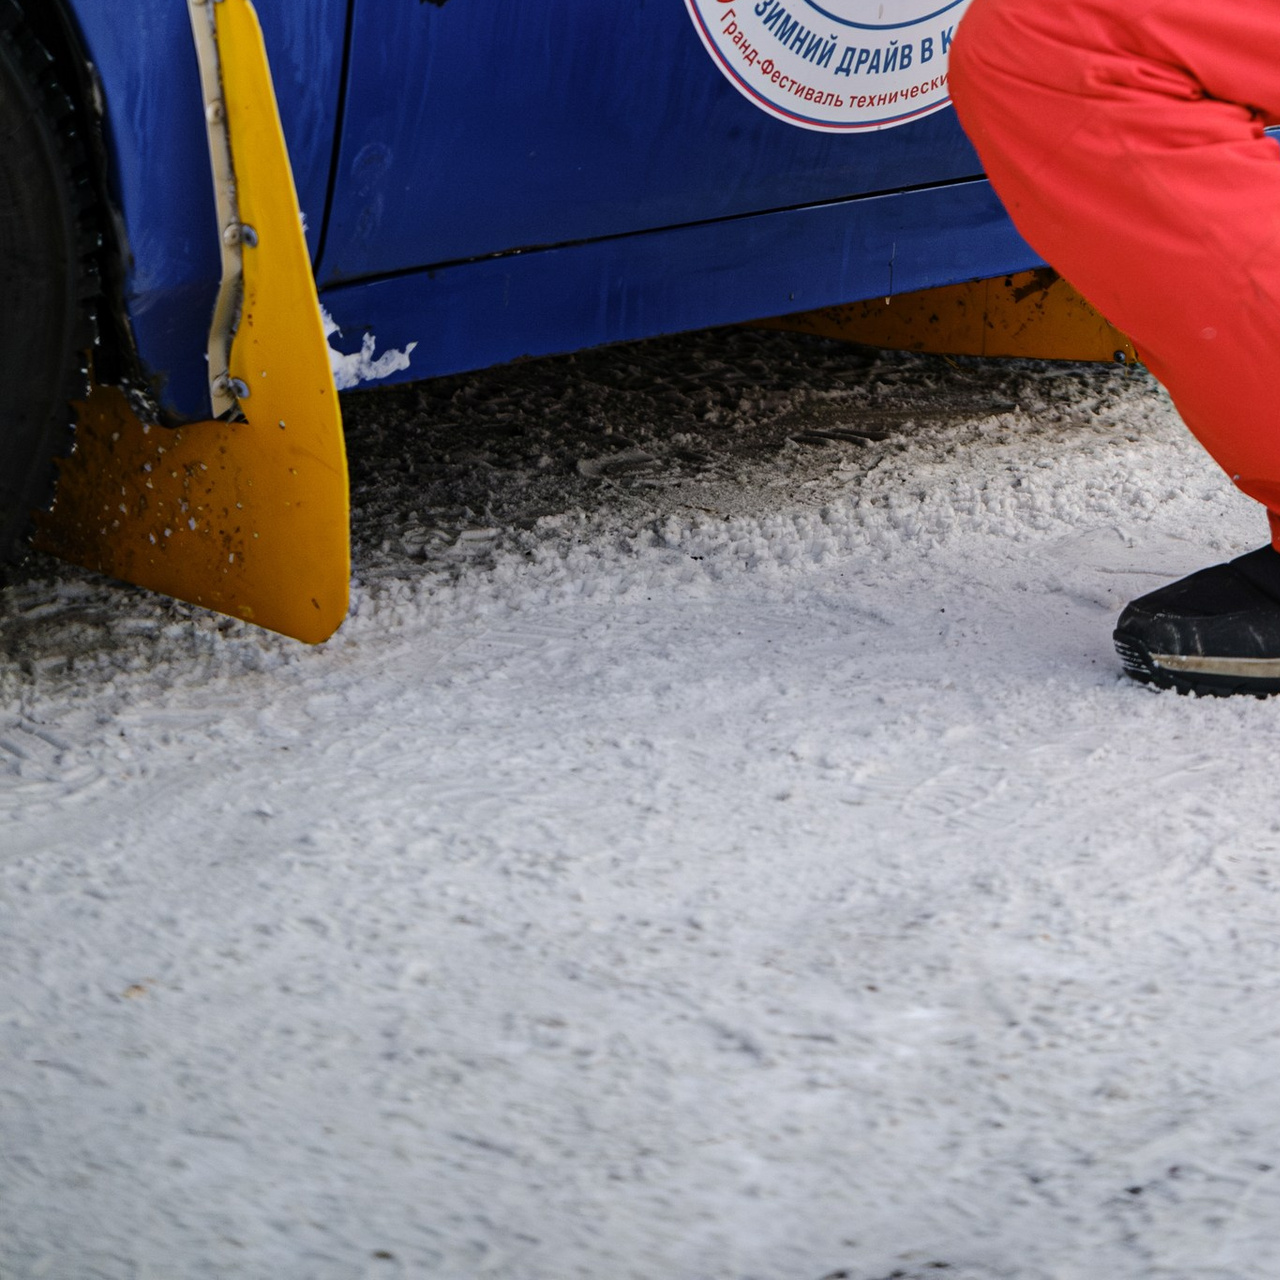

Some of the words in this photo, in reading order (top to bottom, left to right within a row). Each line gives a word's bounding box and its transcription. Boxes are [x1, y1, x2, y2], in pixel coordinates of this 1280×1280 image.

[720, 8, 844, 108] Гранд-Фестиваль
[834, 40, 913, 77] ДРАЙВ
[921, 37, 934, 64] В
